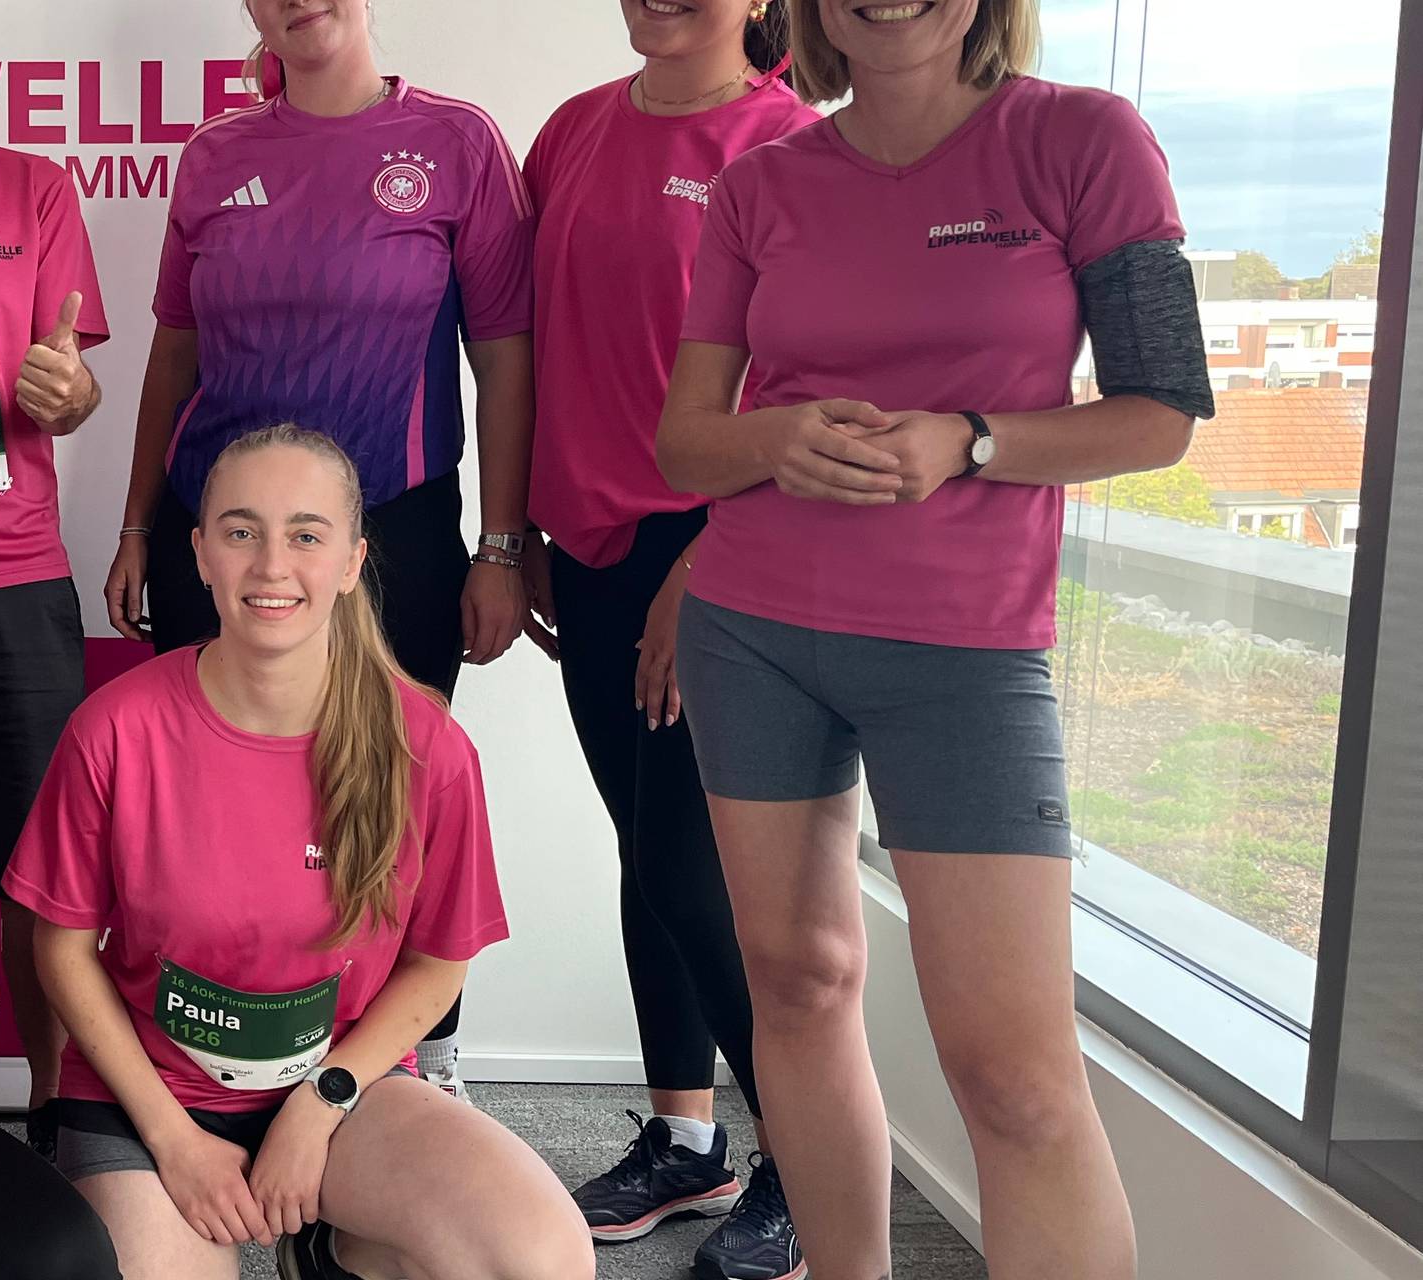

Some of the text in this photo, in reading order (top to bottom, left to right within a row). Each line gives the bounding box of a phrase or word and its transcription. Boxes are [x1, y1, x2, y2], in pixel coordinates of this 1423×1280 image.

[66, 156, 168, 198] MM
[667, 176, 708, 193] RADIO
[662, 184, 709, 205] LIPPEW
[927, 229, 1042, 249] LIPPEWELLE
[928, 220, 986, 238] RADIO
[171, 975, 330, 1011] 16. AOK-Firmenlauf Hamm
[166, 991, 241, 1031] Paula
[166, 1018, 221, 1048] 1126
[278, 1059, 308, 1077] AOK
